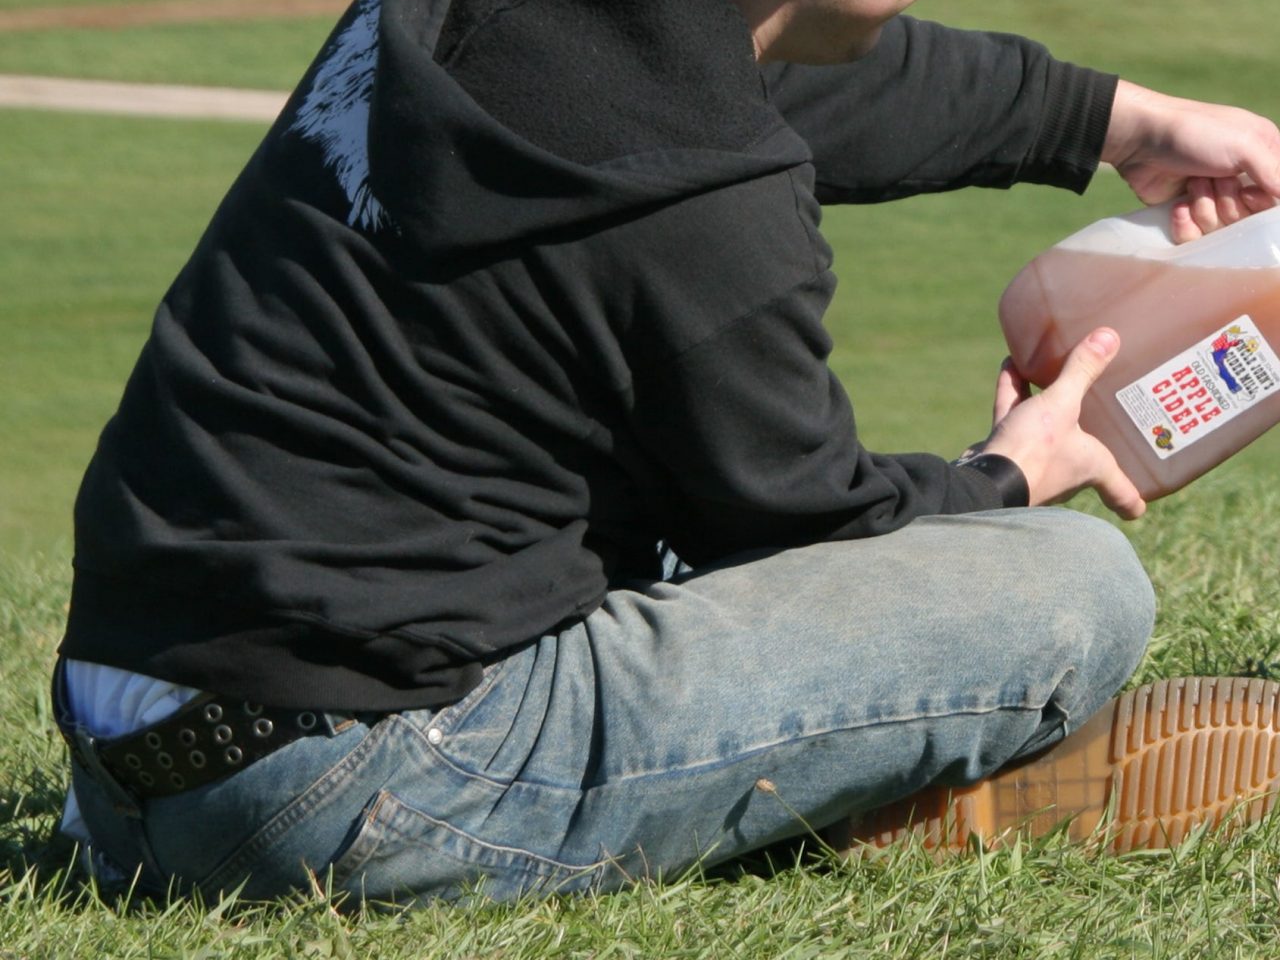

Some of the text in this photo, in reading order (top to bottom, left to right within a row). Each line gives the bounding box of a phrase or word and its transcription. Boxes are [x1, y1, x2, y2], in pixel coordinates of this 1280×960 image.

[1191, 360, 1205, 376] OLD
[1201, 374, 1231, 410] FASHIONED
[1224, 351, 1246, 376] CIDER
[1151, 379, 1200, 435] CIDER
[1172, 365, 1221, 423] APPLE
